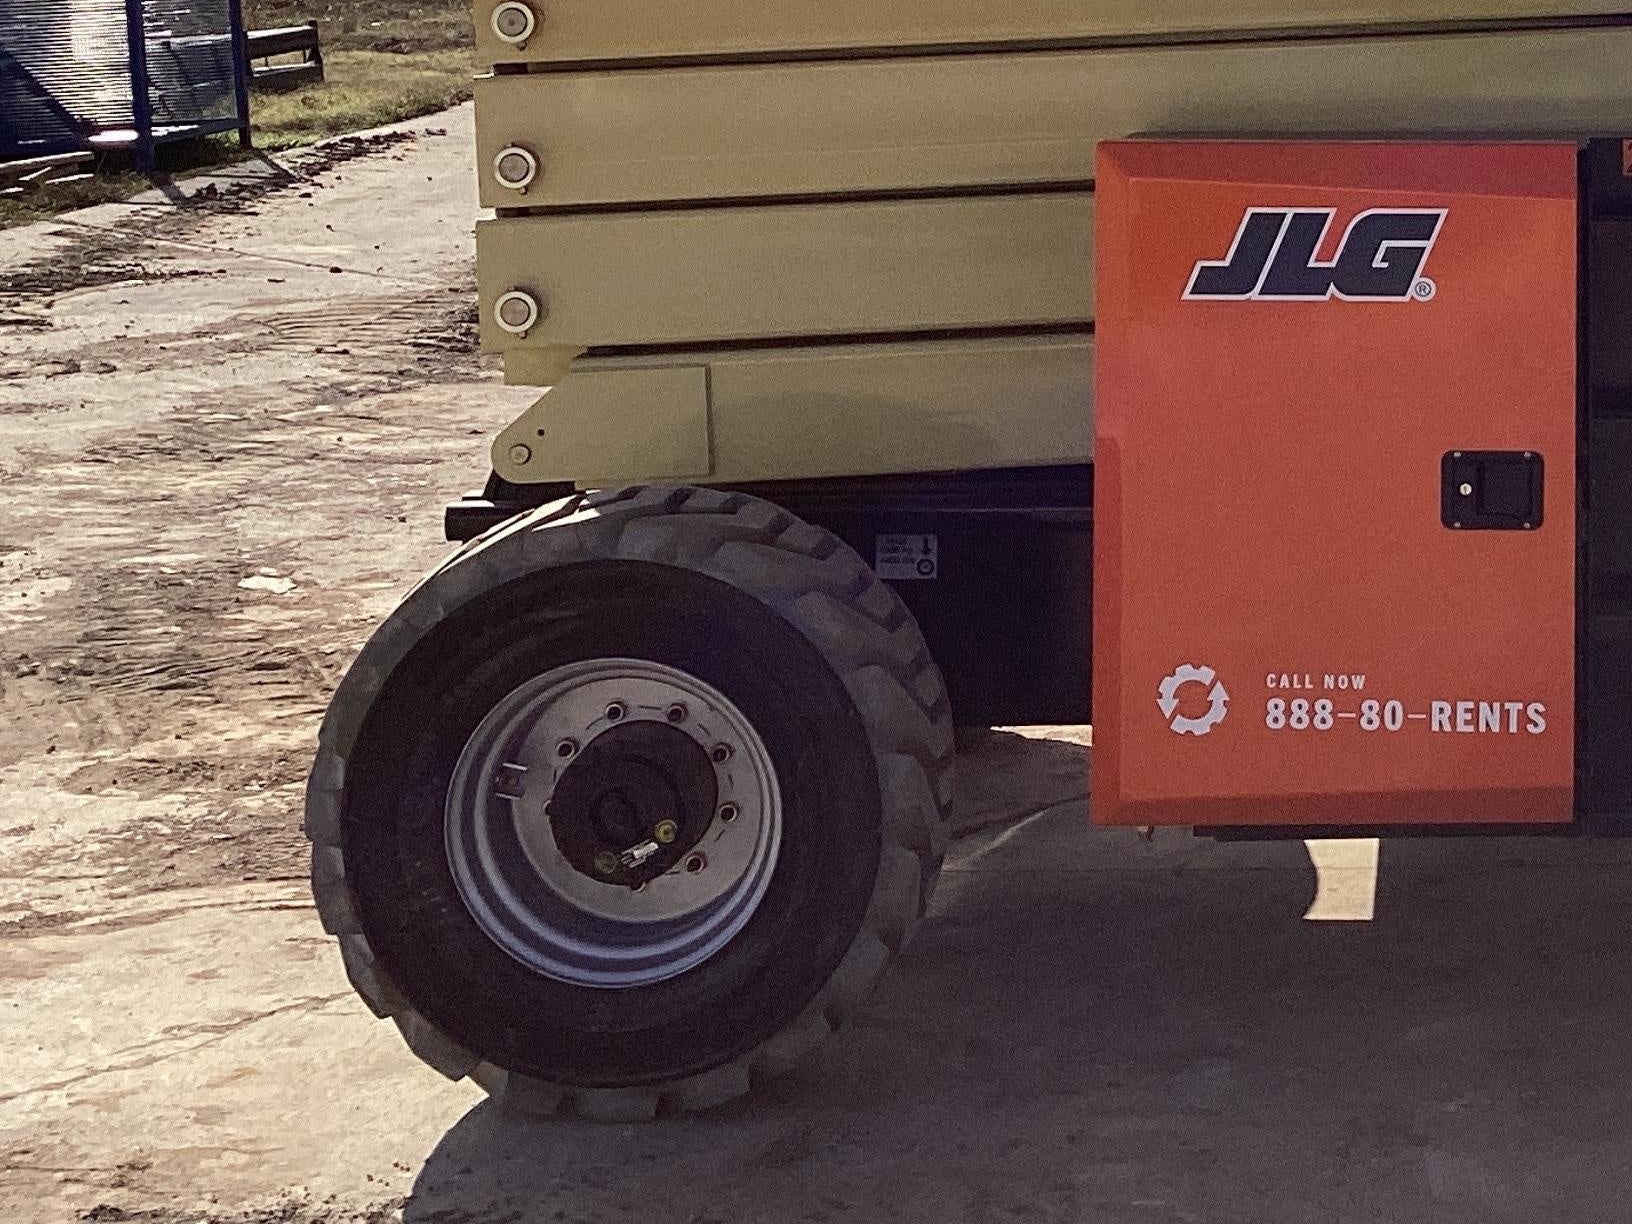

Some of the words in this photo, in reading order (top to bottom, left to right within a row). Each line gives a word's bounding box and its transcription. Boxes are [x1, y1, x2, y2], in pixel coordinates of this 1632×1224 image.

[1180, 206, 1449, 302] JLG
[1266, 673, 1314, 690] CALL
[1323, 673, 1366, 691] NOW
[1265, 697, 1547, 735] 888-80-RENTS
